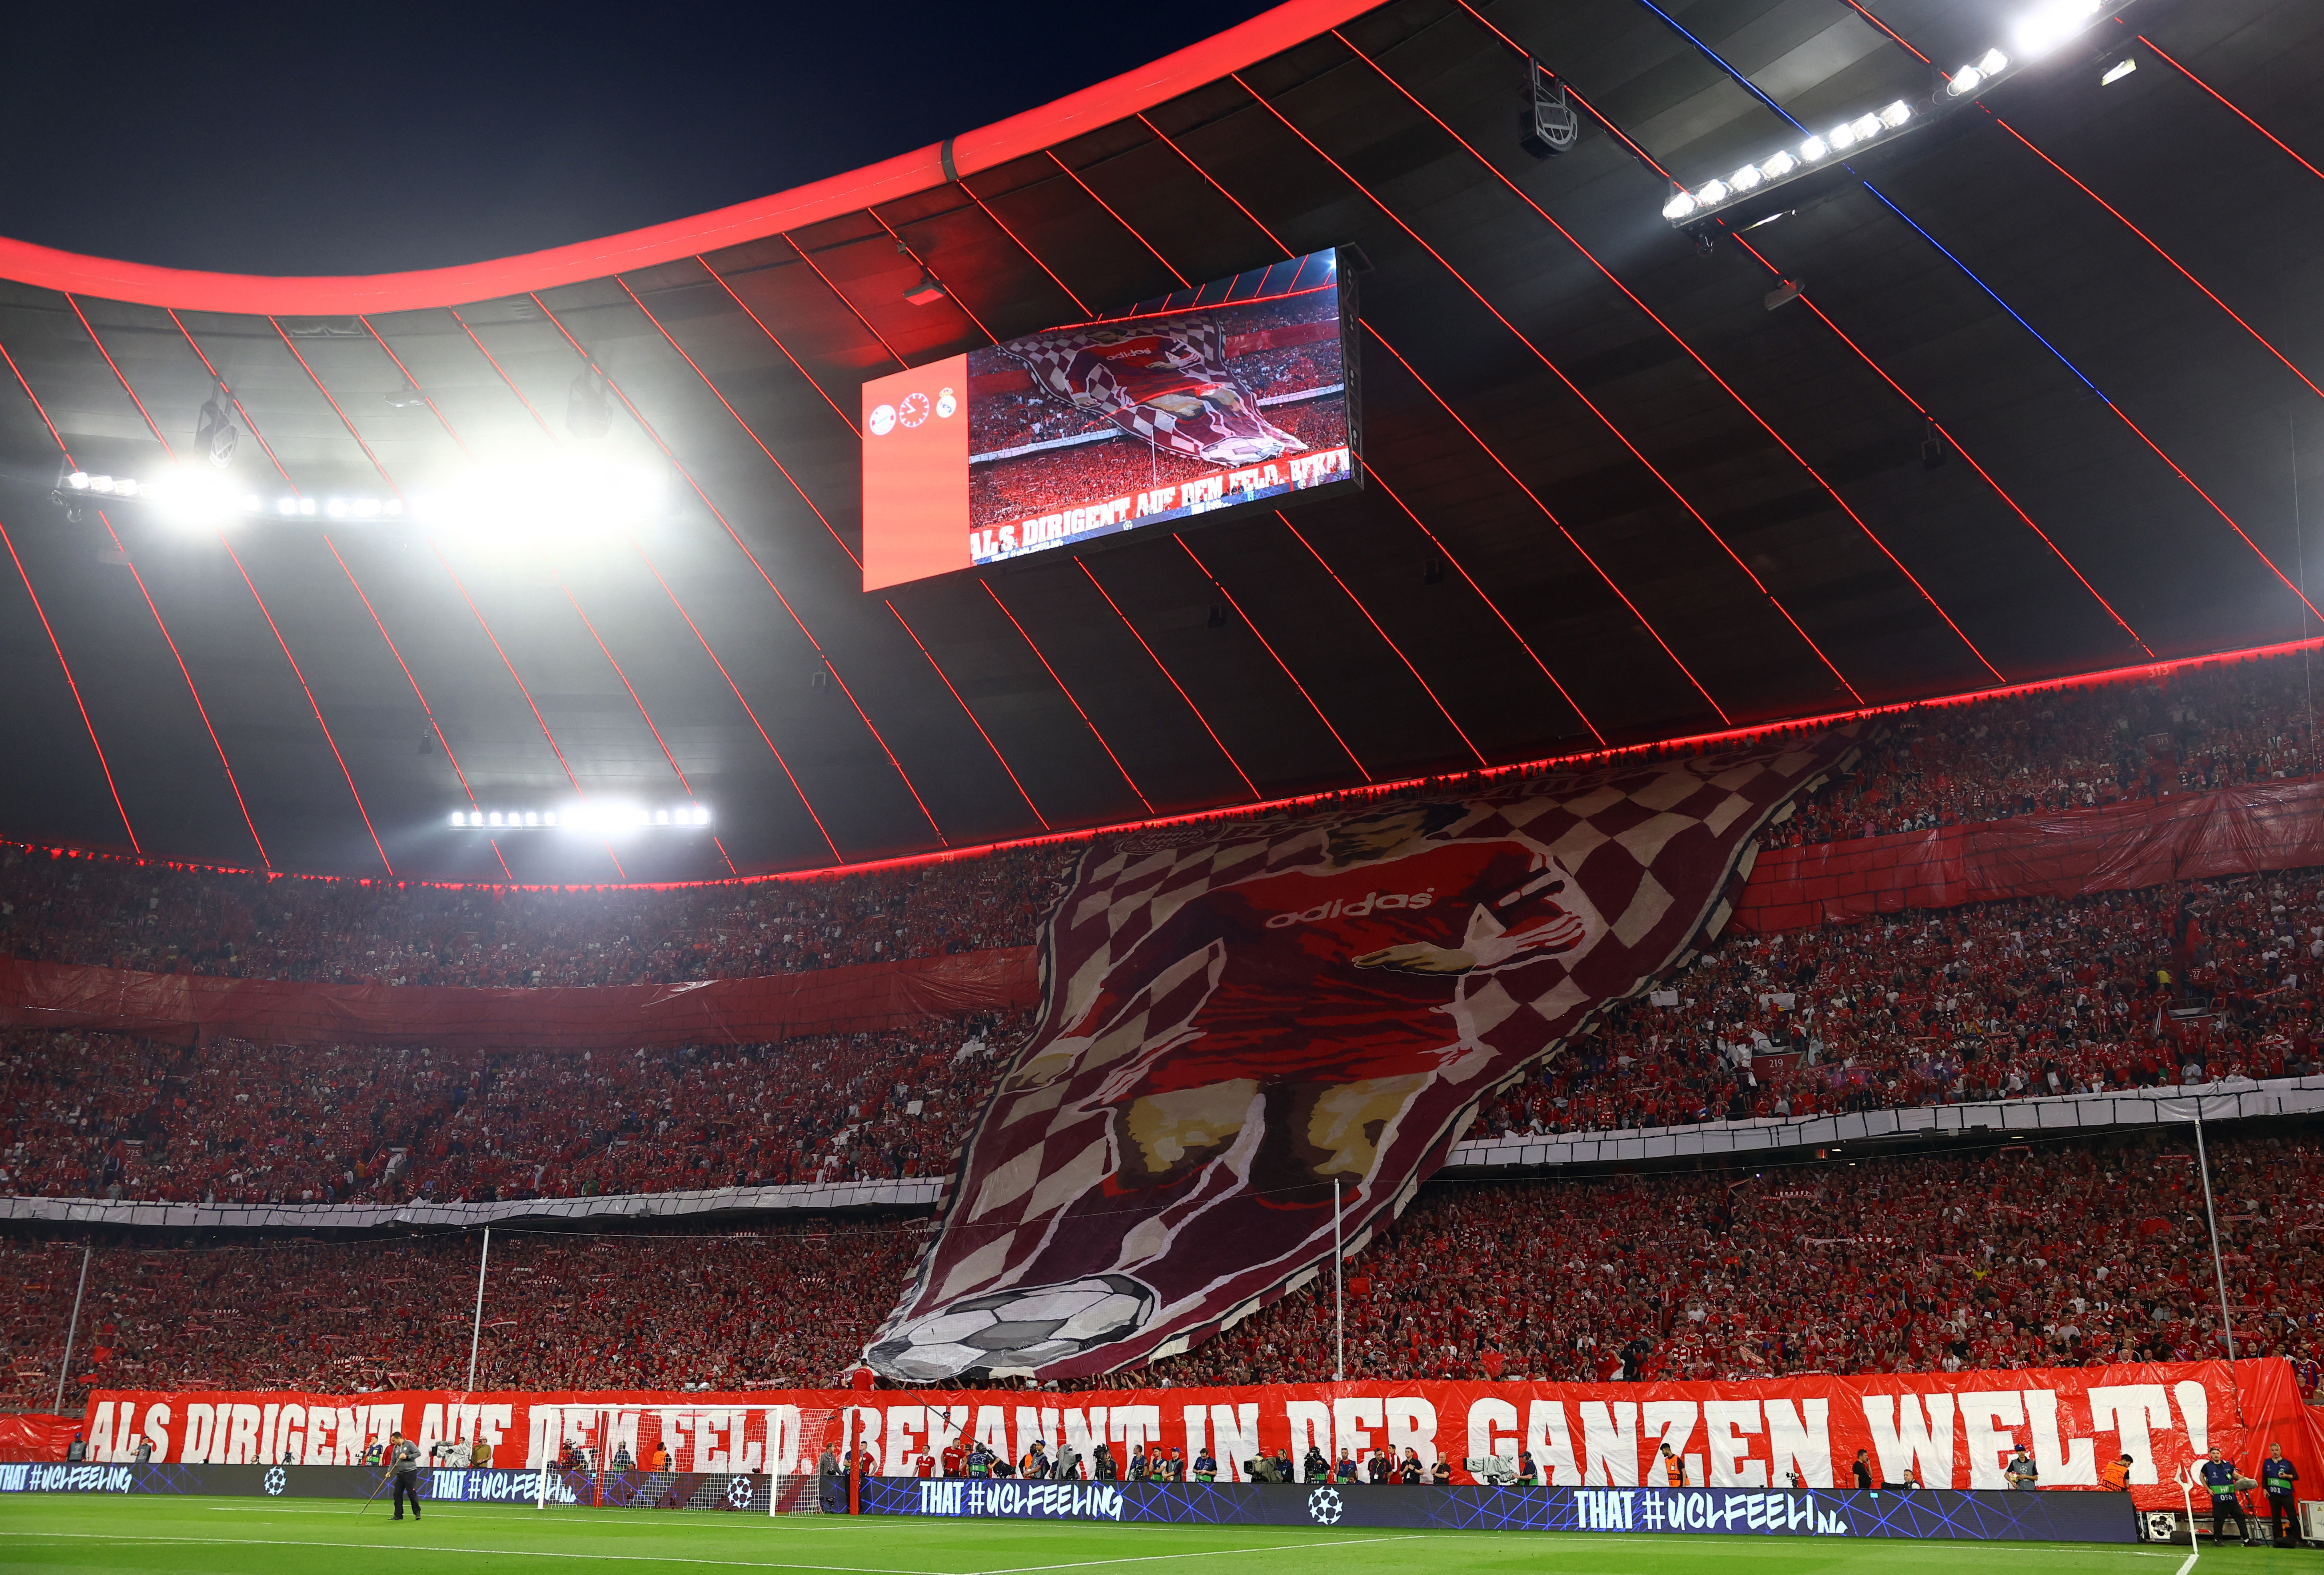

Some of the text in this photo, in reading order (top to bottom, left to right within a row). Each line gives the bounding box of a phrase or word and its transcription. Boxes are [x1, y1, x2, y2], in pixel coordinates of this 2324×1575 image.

[1107, 348, 1152, 360] adidas
[970, 525, 1014, 560] ALS
[1022, 497, 1130, 546] DIRIGENT
[1136, 486, 1176, 517] AUF
[1181, 475, 1223, 507] DEM
[2148, 664, 2169, 678] 313
[940, 853, 954, 862] 318
[1265, 887, 1435, 929] adidas
[2182, 1021, 2199, 1031] 28
[1768, 1059, 1783, 1068] 219
[833, 1377, 838, 1386] 72
[88, 1401, 171, 1463] ALS
[181, 1403, 403, 1466] DIRIGENT
[415, 1403, 512, 1468] AUF
[525, 1405, 641, 1471] DEM
[838, 1405, 1160, 1481] BEKANNT
[1182, 1403, 1259, 1483] IN
[1286, 1397, 1439, 1485] DER
[1467, 1397, 1834, 1488] GANZEN
[1862, 1380, 2209, 1490] WELT!
[29, 1464, 134, 1494] #UCLFEELING
[432, 1471, 467, 1499] THAT
[919, 1481, 1123, 1522] THAT #UCLFEELING
[1574, 1491, 1635, 1529] THAT
